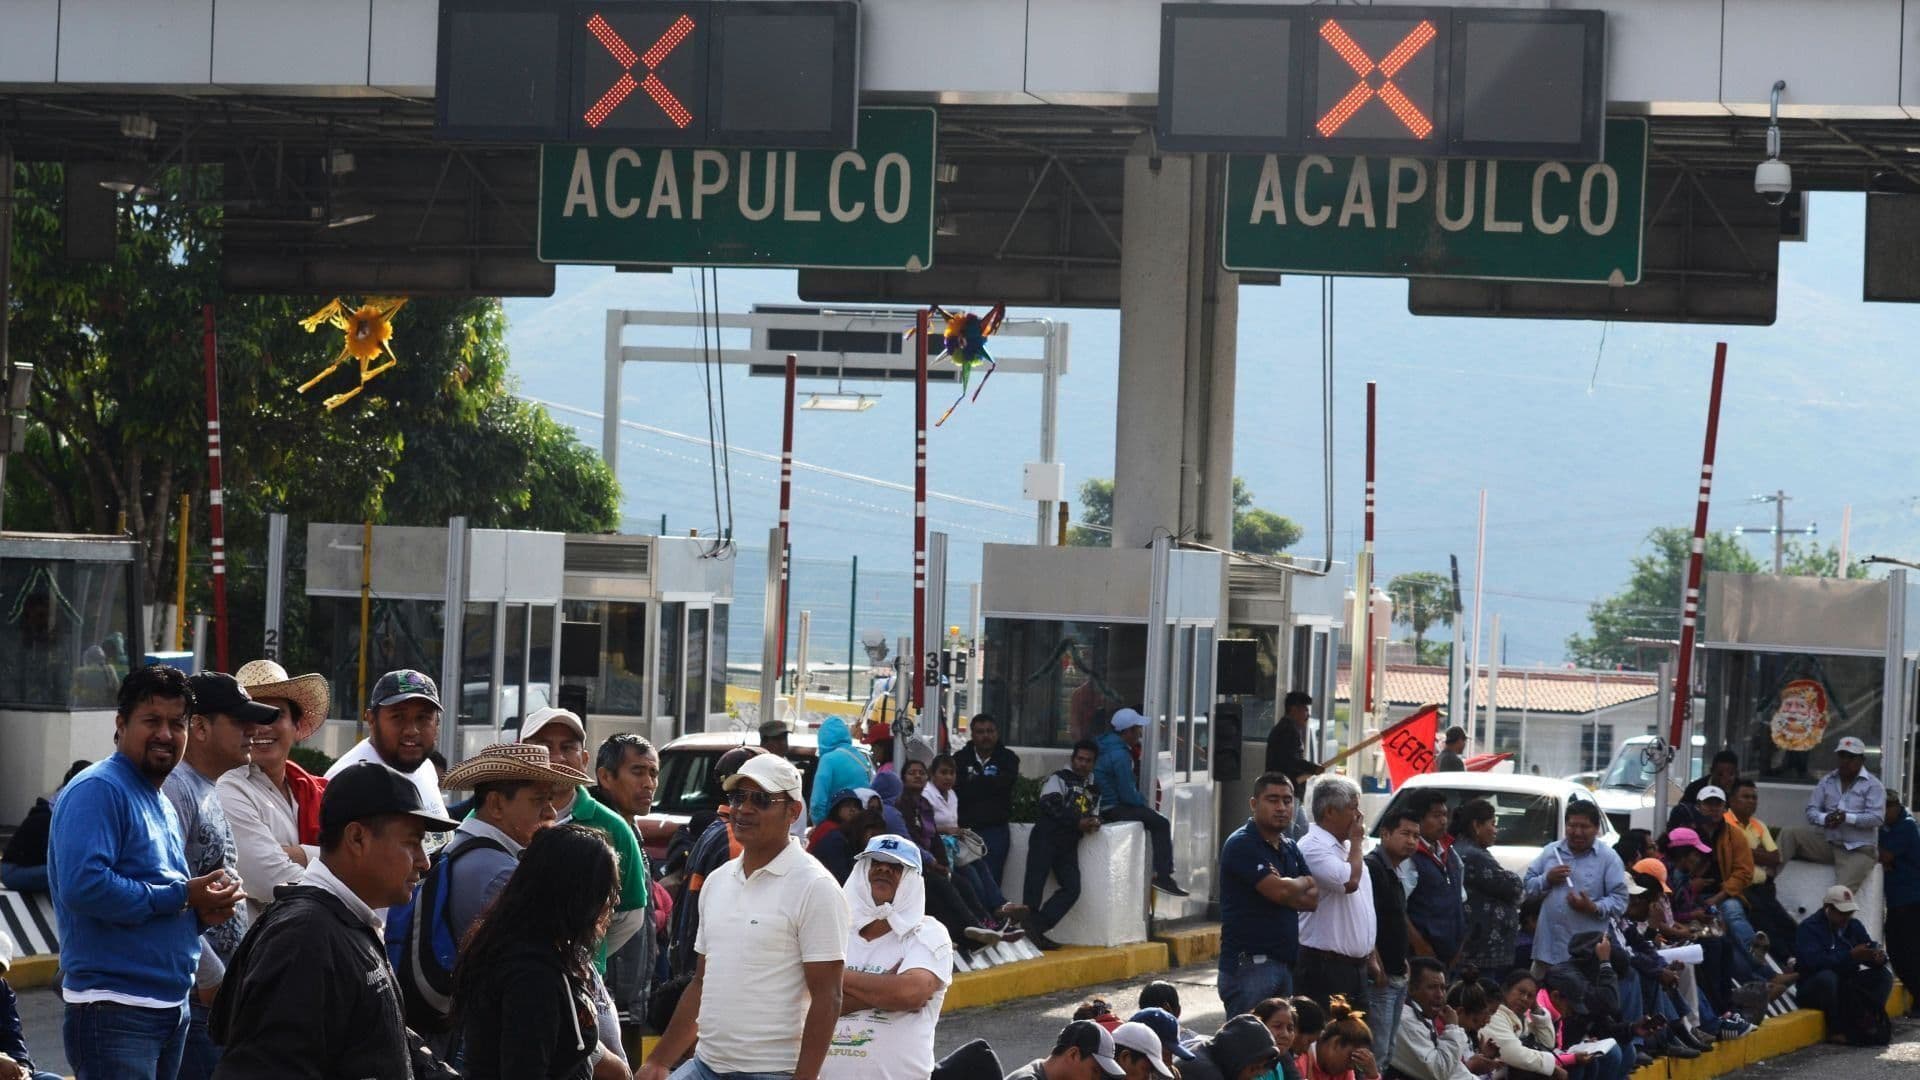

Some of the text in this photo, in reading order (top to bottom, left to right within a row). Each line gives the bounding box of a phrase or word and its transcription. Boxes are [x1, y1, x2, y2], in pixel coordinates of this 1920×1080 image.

[562, 147, 911, 224] ACAPULCO
[1249, 154, 1619, 236] ACAPULCO
[827, 1048, 868, 1058] APULCO
